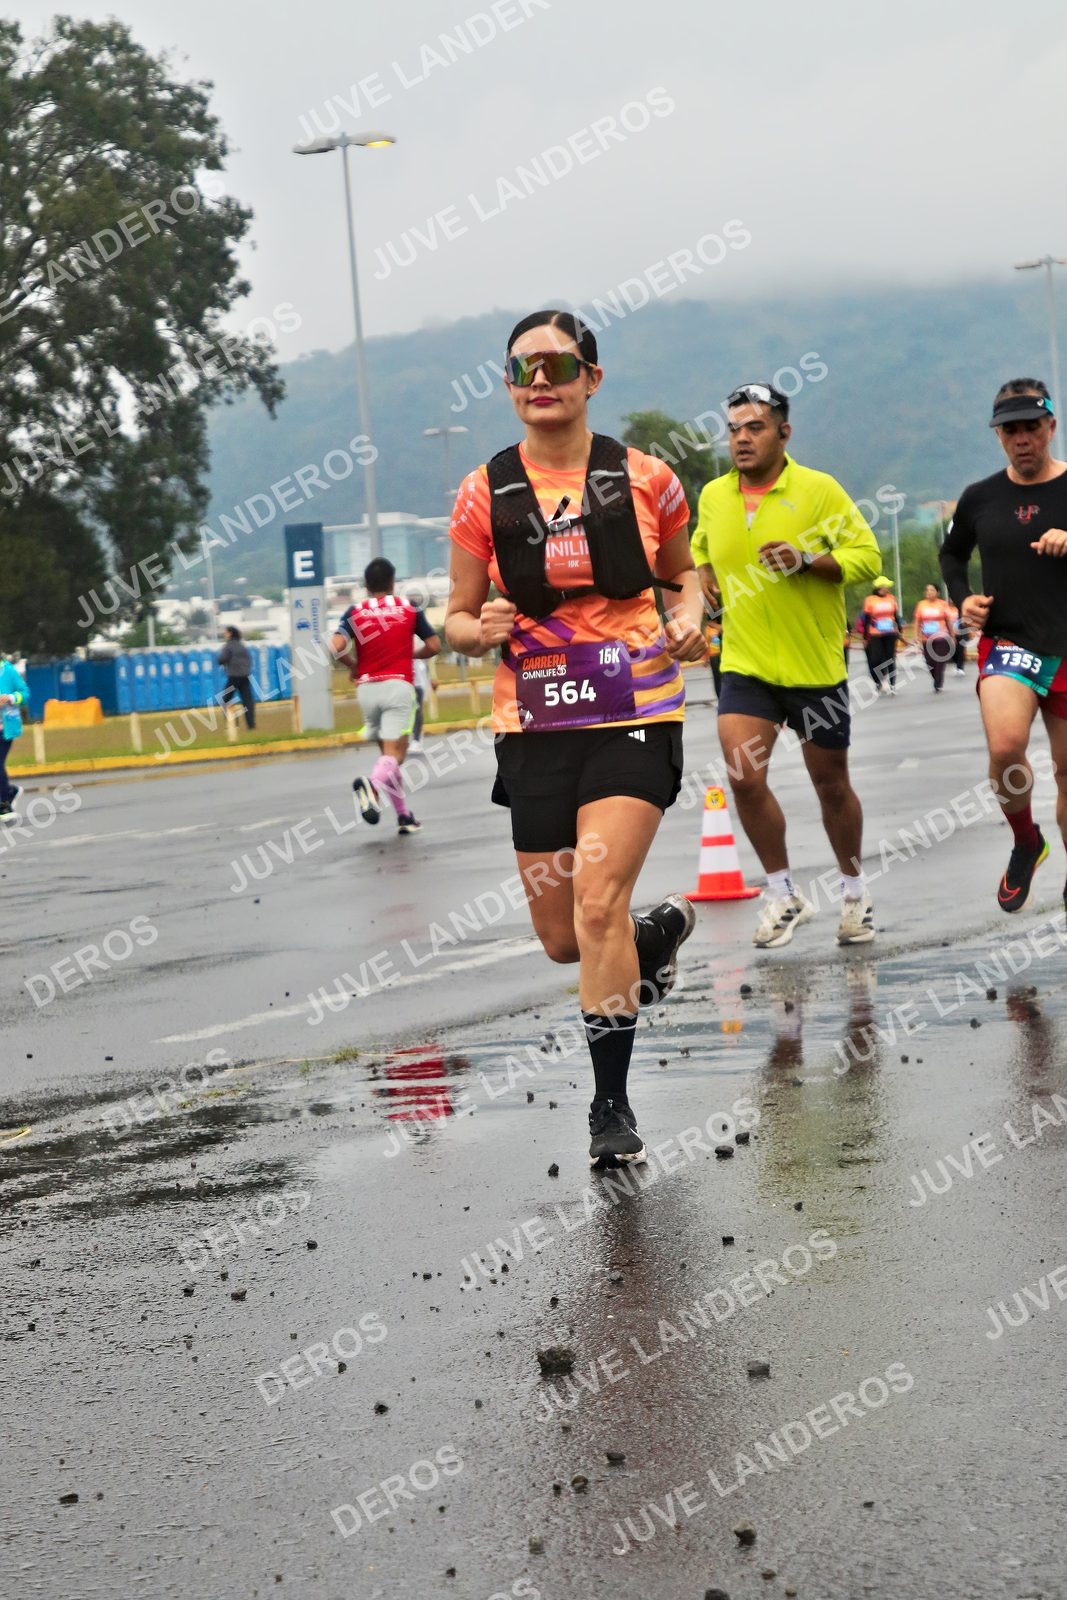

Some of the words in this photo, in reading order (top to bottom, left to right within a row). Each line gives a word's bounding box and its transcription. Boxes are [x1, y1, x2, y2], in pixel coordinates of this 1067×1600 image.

[293, 550, 315, 579] E
[522, 653, 567, 671] CARRERA
[1001, 652, 1042, 674] 1353
[544, 679, 597, 706] 564
